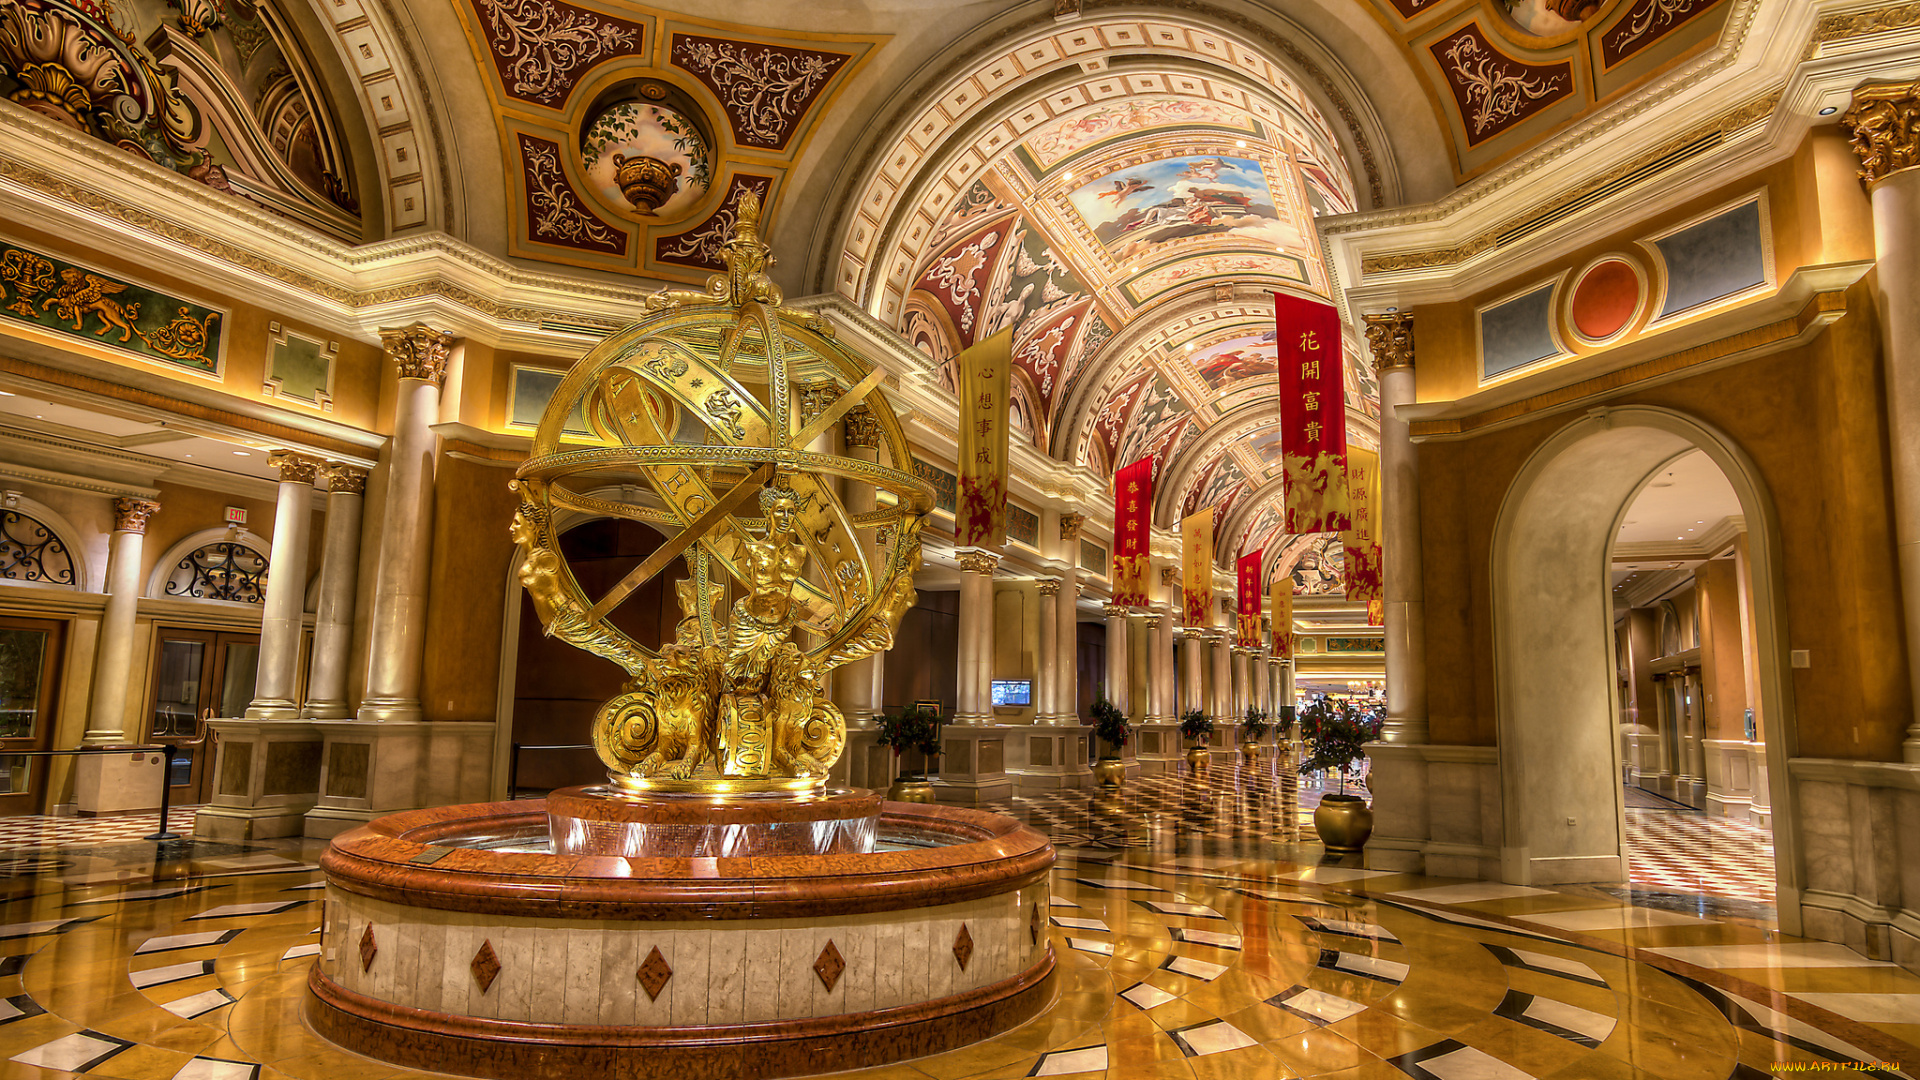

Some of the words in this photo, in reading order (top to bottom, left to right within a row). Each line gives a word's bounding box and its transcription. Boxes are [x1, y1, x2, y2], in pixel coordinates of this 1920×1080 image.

[975, 367, 994, 465] 心想事成
[1299, 330, 1323, 443] 花開富貴
[230, 508, 245, 521] EXIT
[1125, 481, 1139, 550] 恭喜發財
[1351, 467, 1370, 541] 財源廣進
